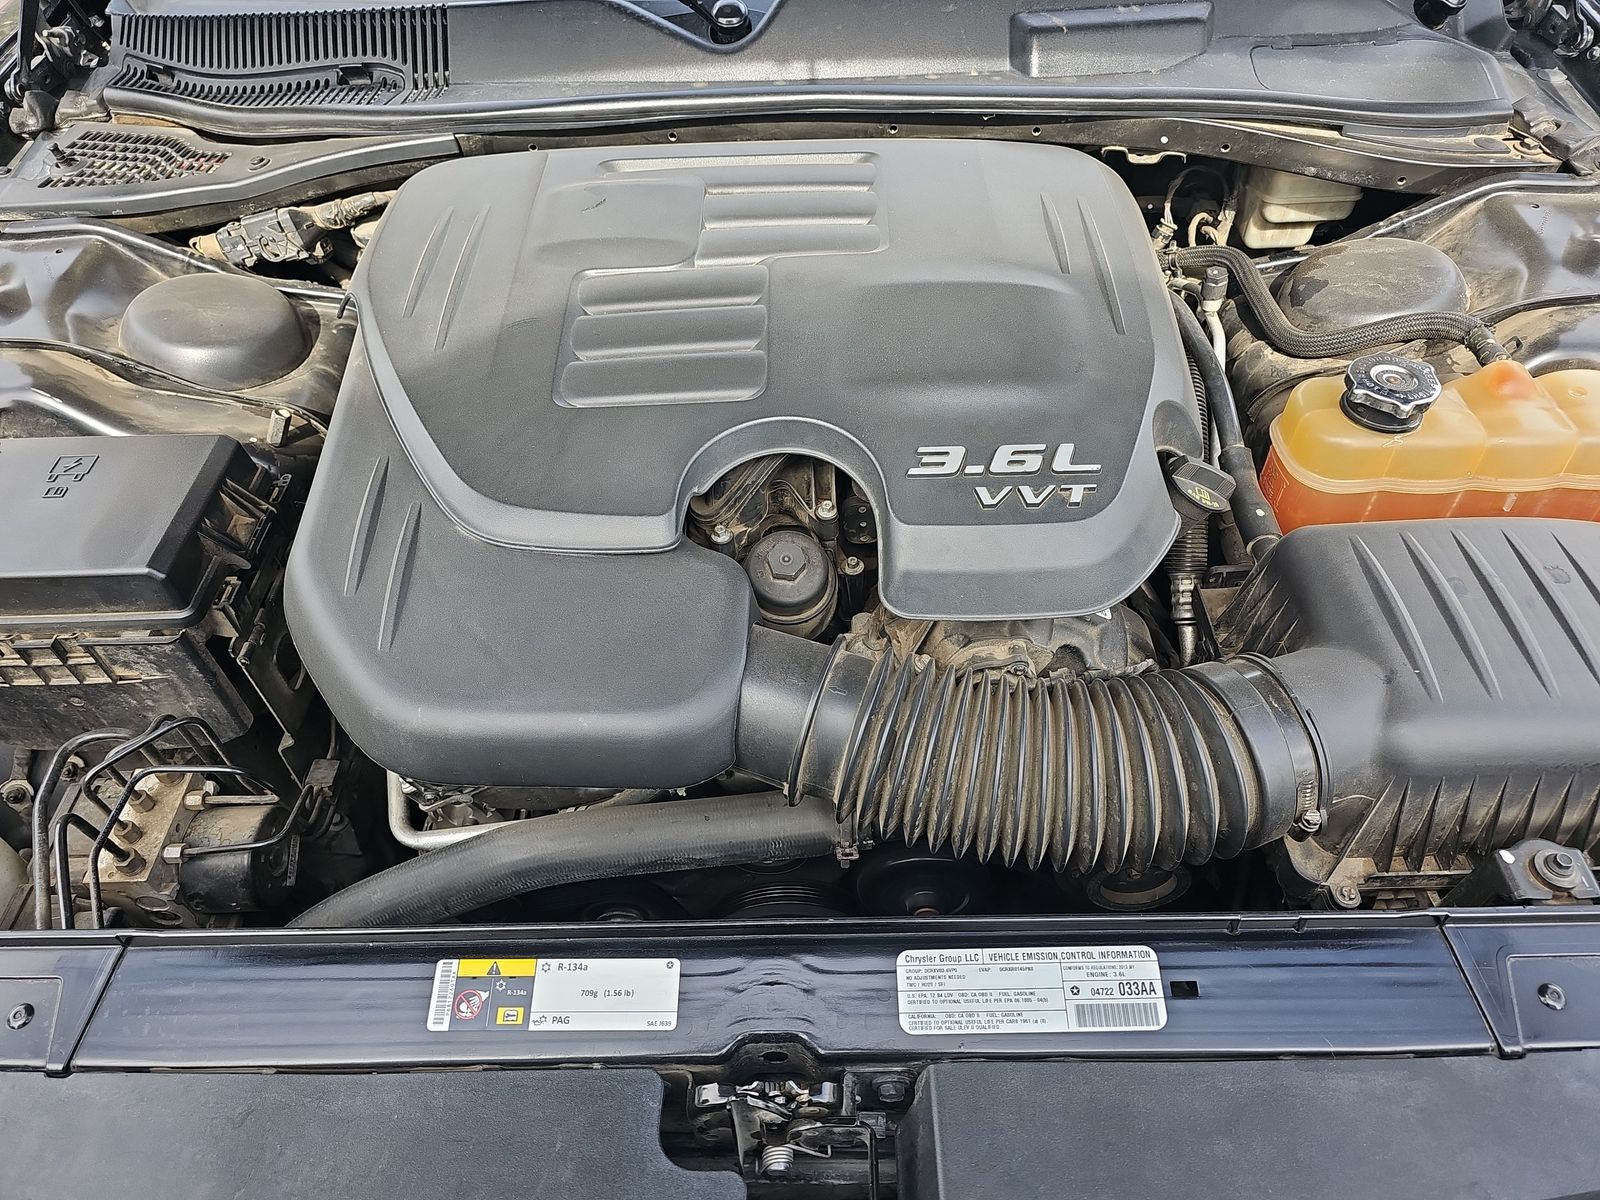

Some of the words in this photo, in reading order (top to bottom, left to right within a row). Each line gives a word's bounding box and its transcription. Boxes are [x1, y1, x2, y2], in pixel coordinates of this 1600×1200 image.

[905, 443, 1101, 478] 3.6L
[973, 484, 1097, 510] VVT
[905, 954, 937, 964] Chrysler
[939, 953, 962, 964] Group
[964, 953, 979, 962] LLC
[988, 952, 1020, 961] VEHICLE
[1022, 952, 1058, 960] EMISSION
[1060, 951, 1096, 960] CONTROL
[1098, 950, 1151, 959] INFORMATION
[557, 962, 588, 971] R-134a
[580, 989, 598, 998] 709g
[603, 989, 622, 998] (1.56
[624, 989, 634, 998] lb)
[1090, 987, 1115, 996] 04722
[1118, 981, 1157, 996] 033AA
[551, 1015, 570, 1025] PAG
